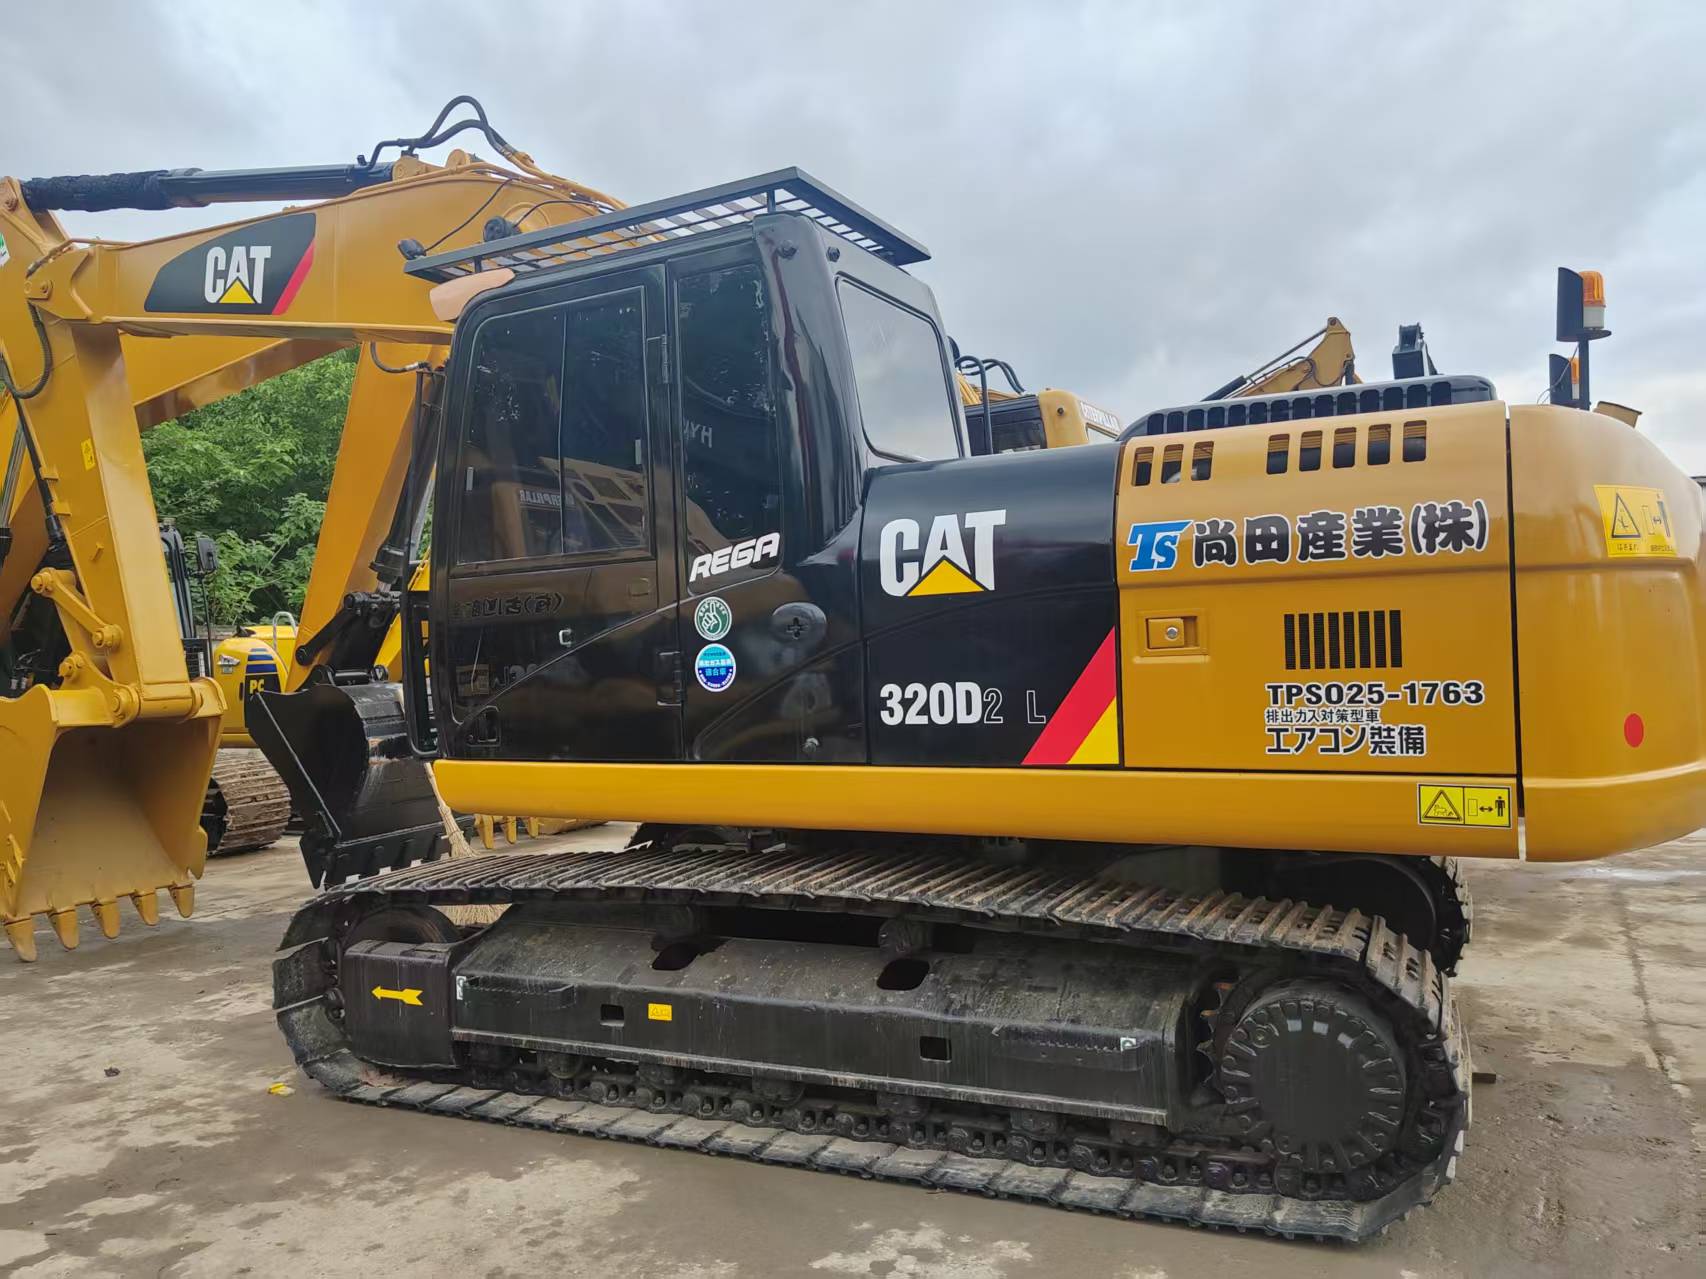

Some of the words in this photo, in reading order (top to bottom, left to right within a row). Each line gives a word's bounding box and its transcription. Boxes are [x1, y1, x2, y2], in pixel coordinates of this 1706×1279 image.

[205, 246, 271, 303] CAT
[689, 532, 780, 582] REGA
[880, 509, 1006, 597] CAT
[1026, 689, 1047, 724] L
[1265, 726, 1426, 756] エアコン装備
